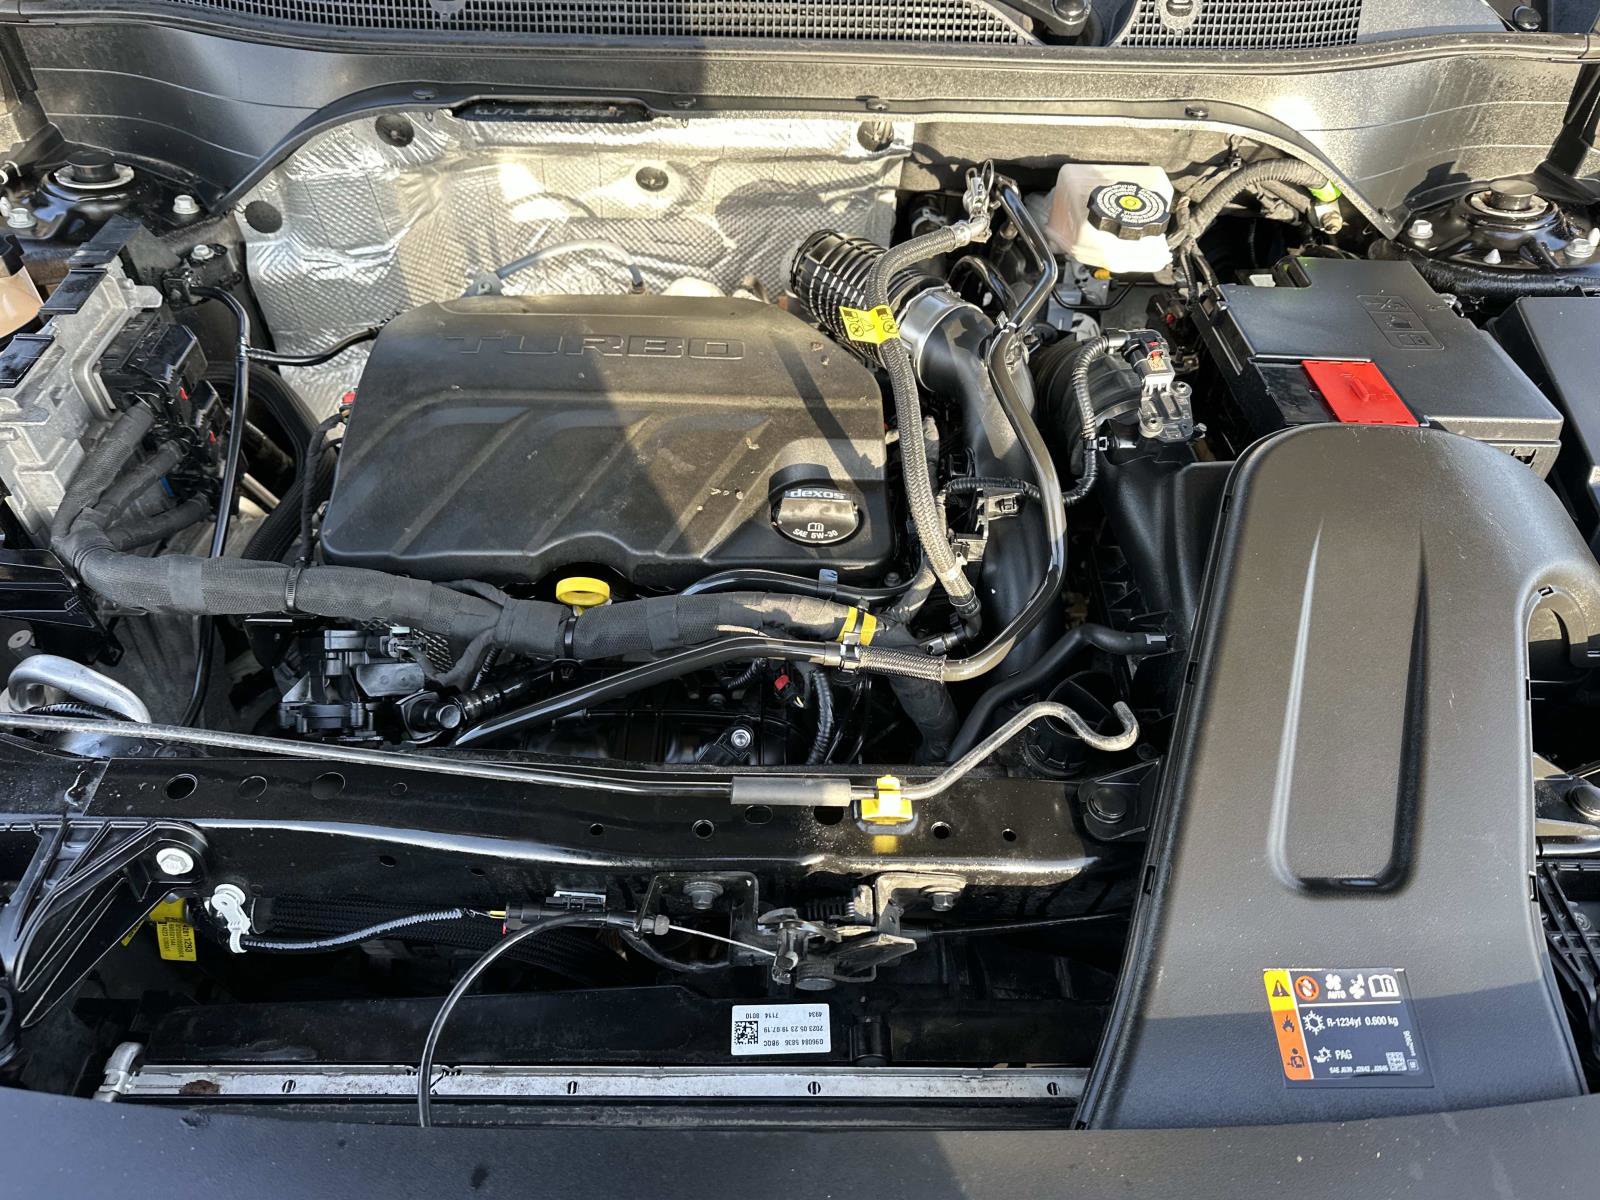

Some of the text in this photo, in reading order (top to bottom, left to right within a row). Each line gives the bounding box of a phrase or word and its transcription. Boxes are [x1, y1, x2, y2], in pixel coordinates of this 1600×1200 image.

[445, 334, 746, 360] TURBO
[790, 489, 844, 499] dexos
[792, 528, 839, 539] SAE 5W-30
[1327, 990, 1347, 999] AUTO
[1326, 1015, 1399, 1029] R-1234yf 0.600 kg
[1334, 1049, 1353, 1060] PAG
